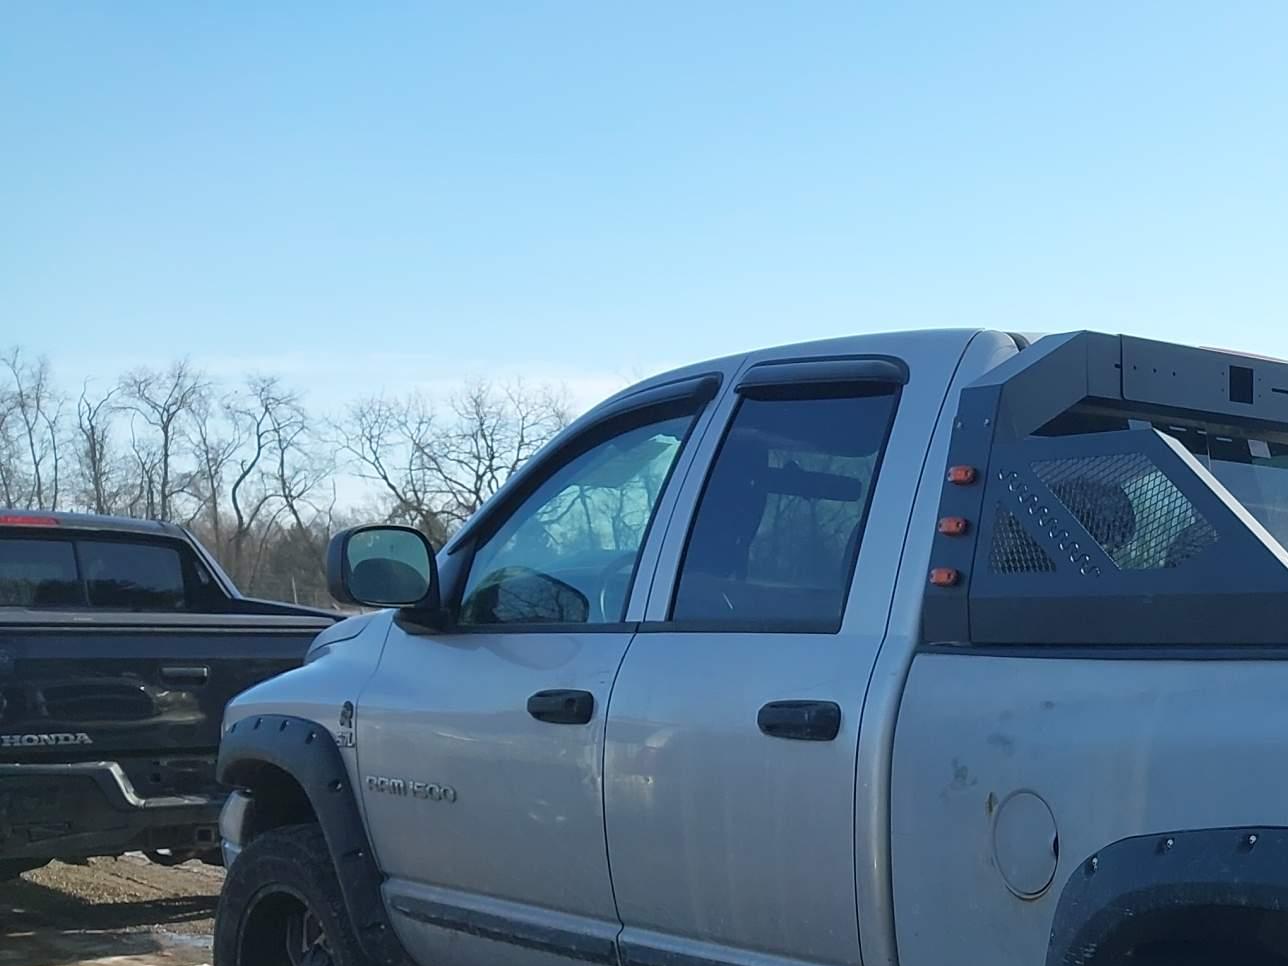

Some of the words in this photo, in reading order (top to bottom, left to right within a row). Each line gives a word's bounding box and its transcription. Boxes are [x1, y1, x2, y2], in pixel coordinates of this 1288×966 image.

[1, 733, 93, 746] HONDA
[366, 776, 407, 796] RAM
[409, 781, 457, 804] 1500
